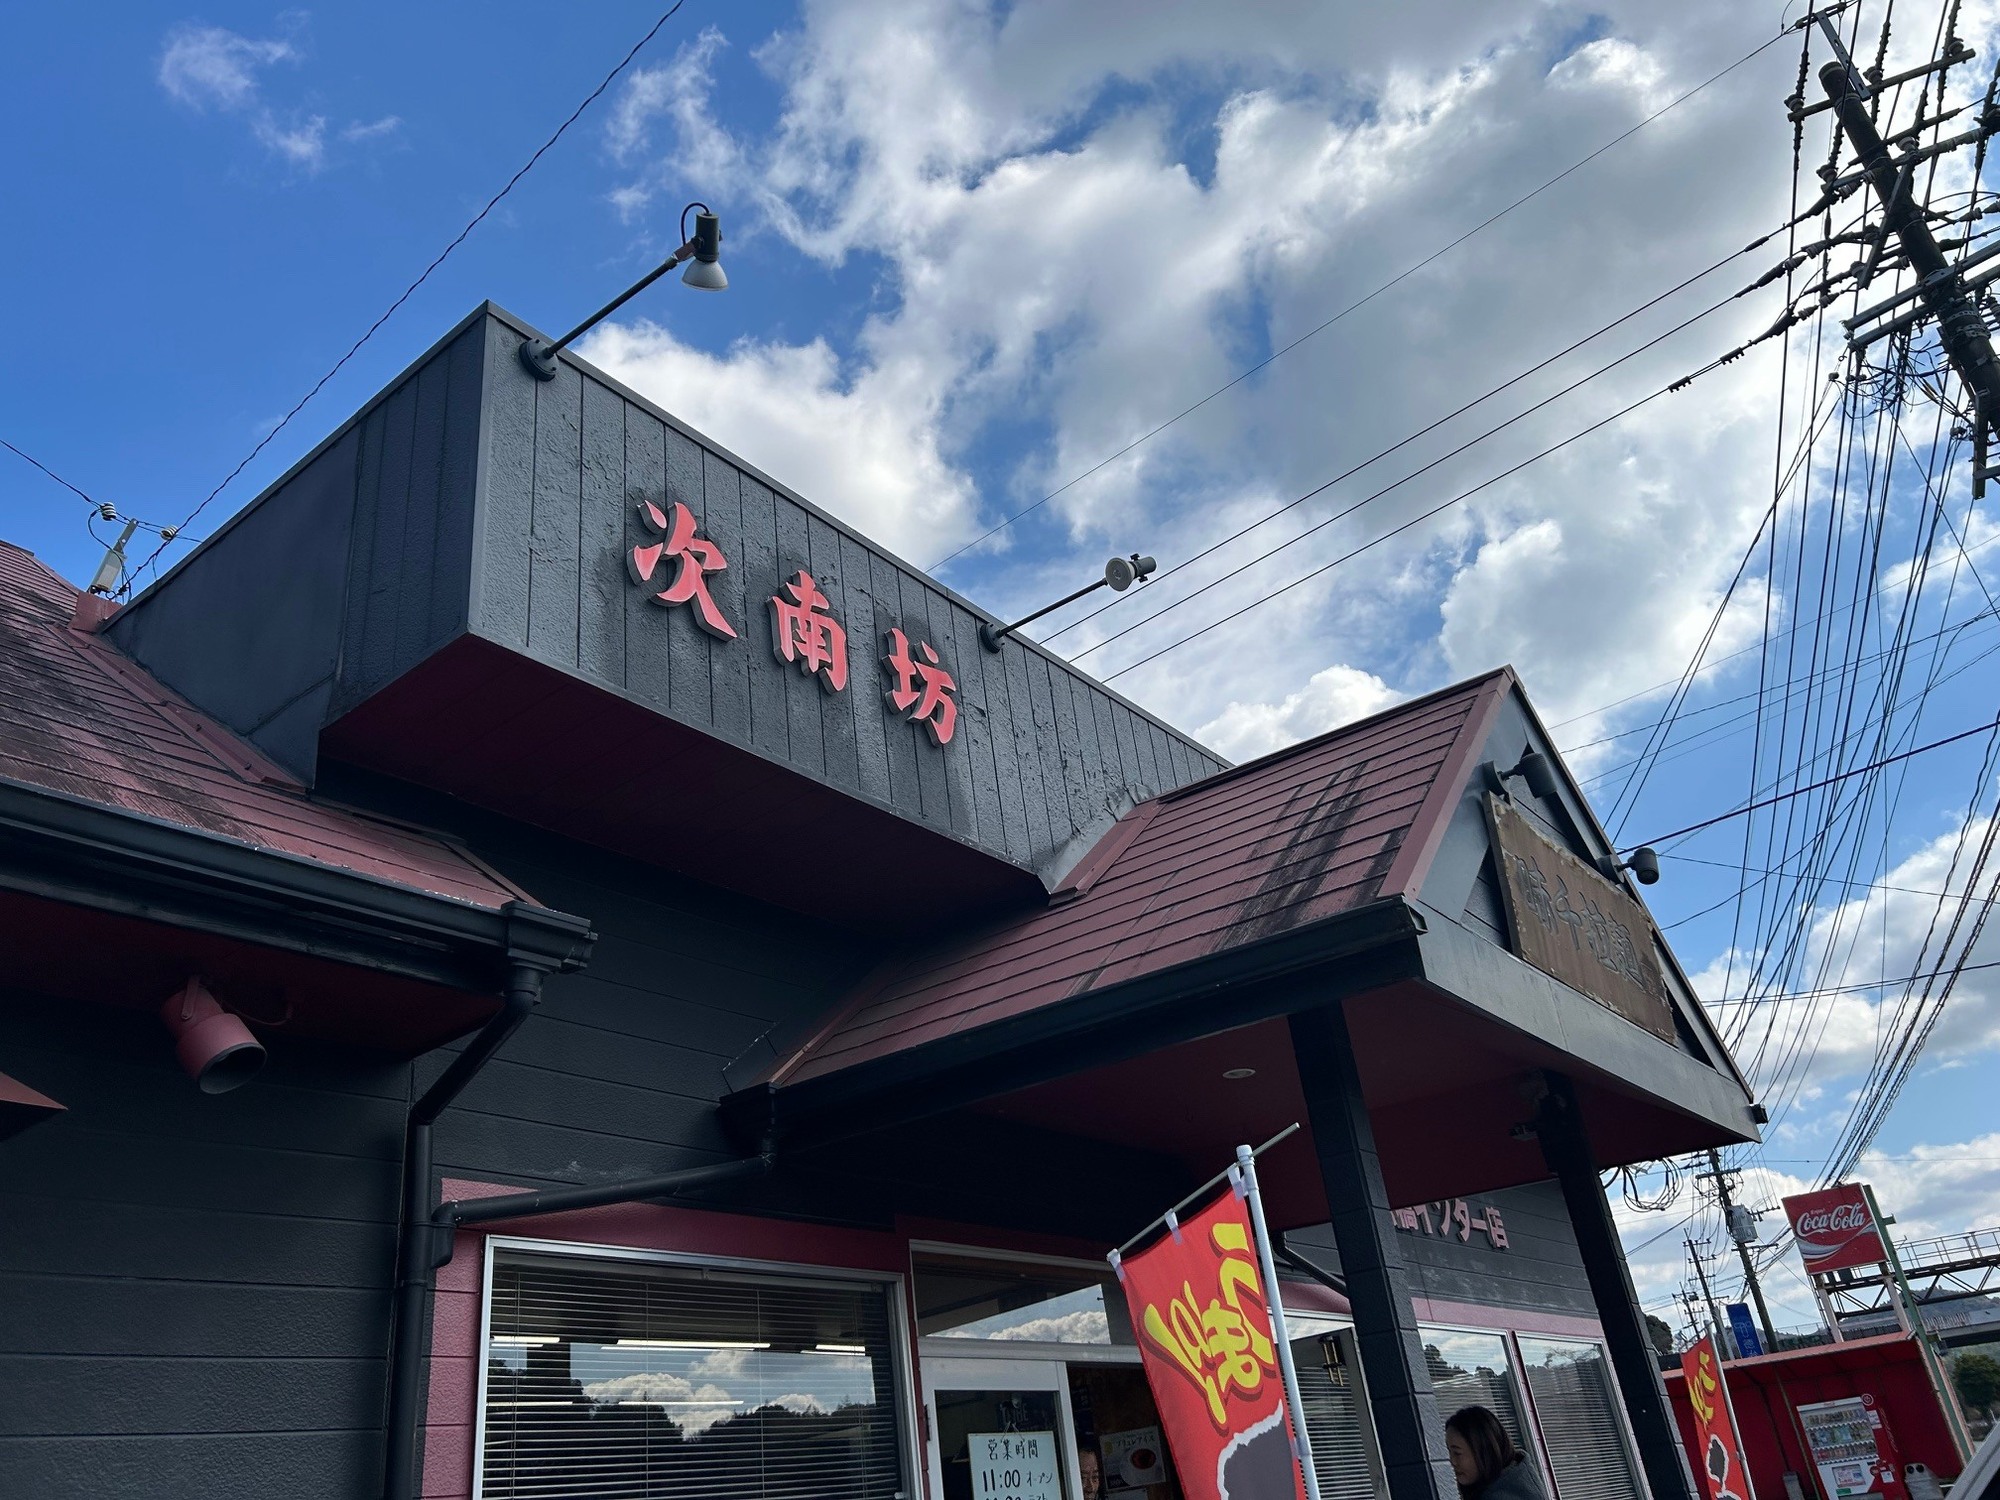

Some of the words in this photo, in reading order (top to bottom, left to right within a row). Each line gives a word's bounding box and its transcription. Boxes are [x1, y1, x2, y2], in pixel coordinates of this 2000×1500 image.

[626, 499, 959, 748] 次南坊
[1796, 1202, 1866, 1237] Coca-Cola
[987, 1438, 1039, 1460] 営業時間
[982, 1468, 1021, 1492] 11:00
